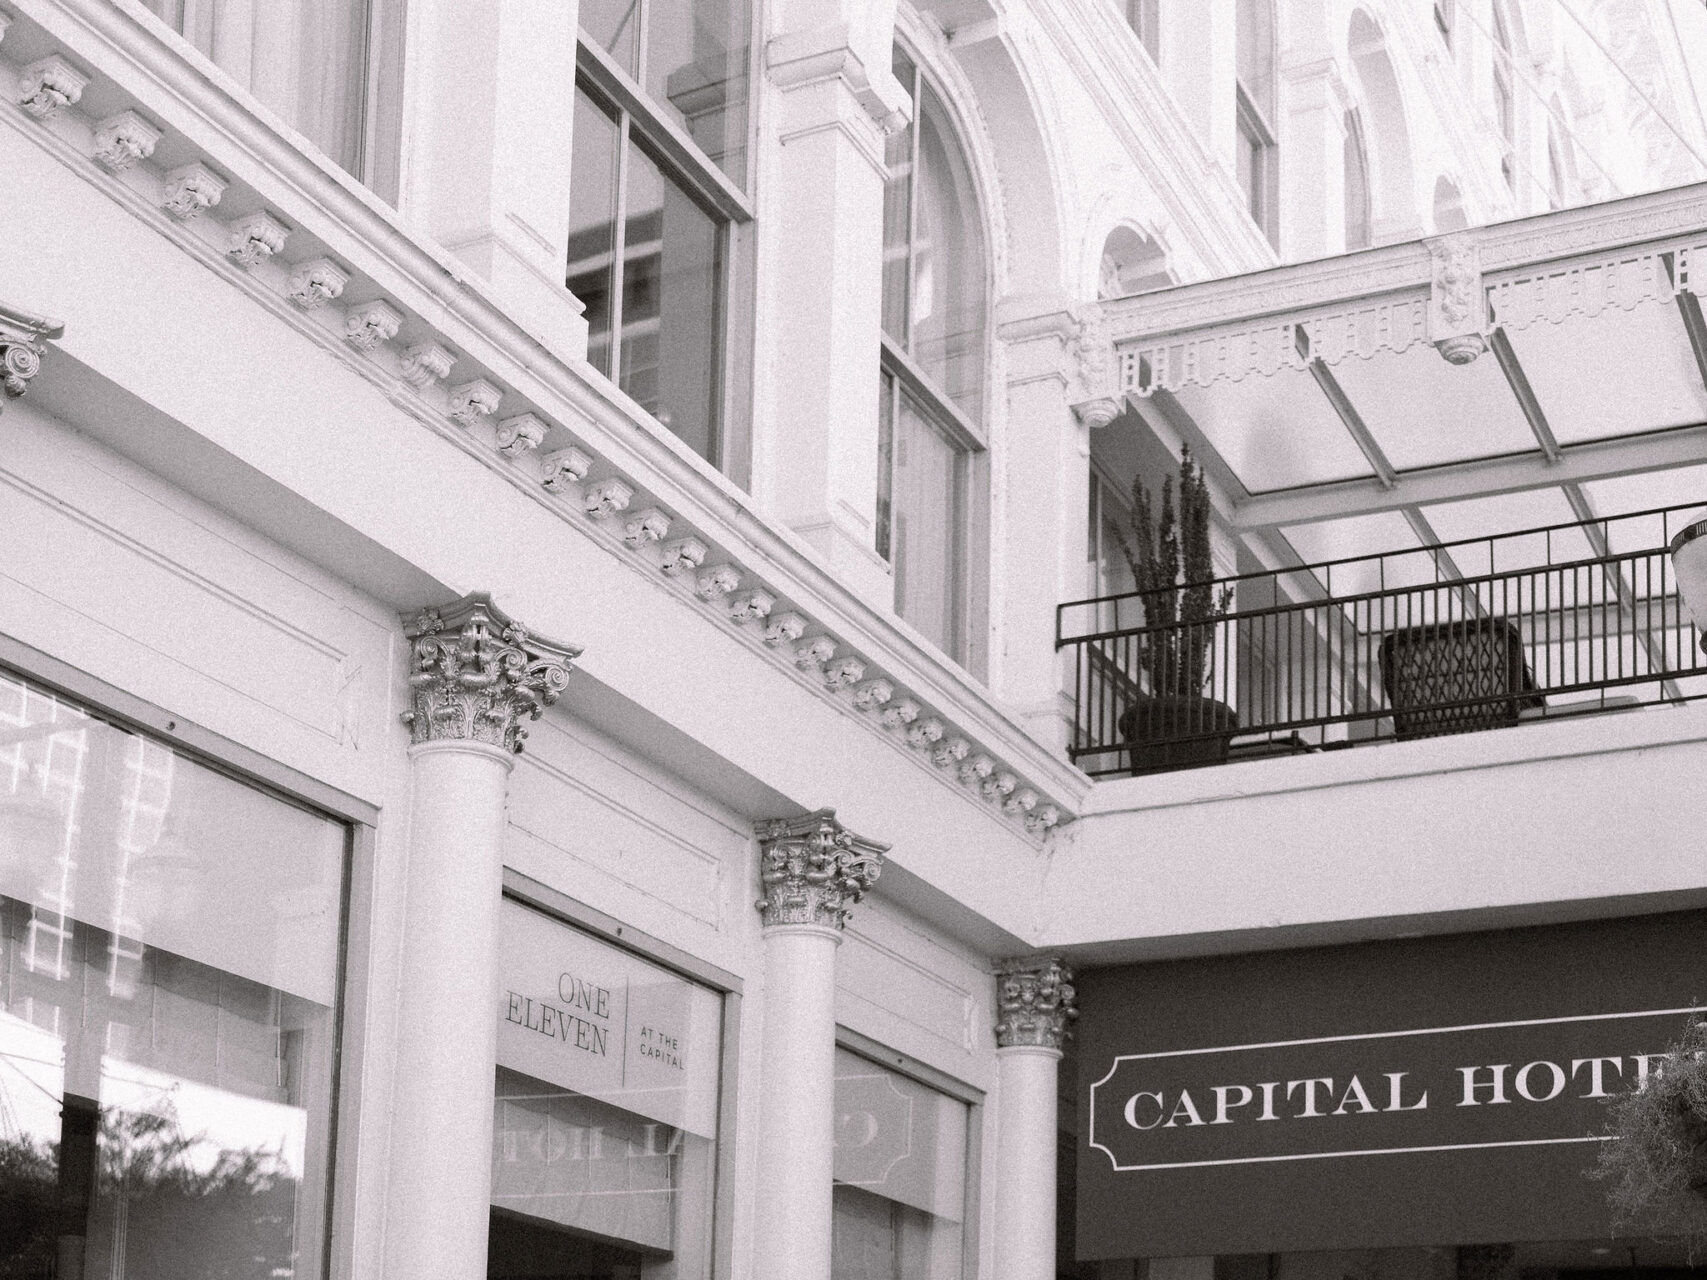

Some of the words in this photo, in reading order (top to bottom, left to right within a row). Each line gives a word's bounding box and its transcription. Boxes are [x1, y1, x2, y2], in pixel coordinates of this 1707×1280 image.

[558, 972, 609, 1019] ONE
[505, 990, 608, 1057] ELEVEN
[641, 1026, 654, 1040] AT
[659, 1033, 678, 1050] THE
[640, 1044, 684, 1070] CAPITAL
[1123, 1071, 1427, 1130] CAPITAL
